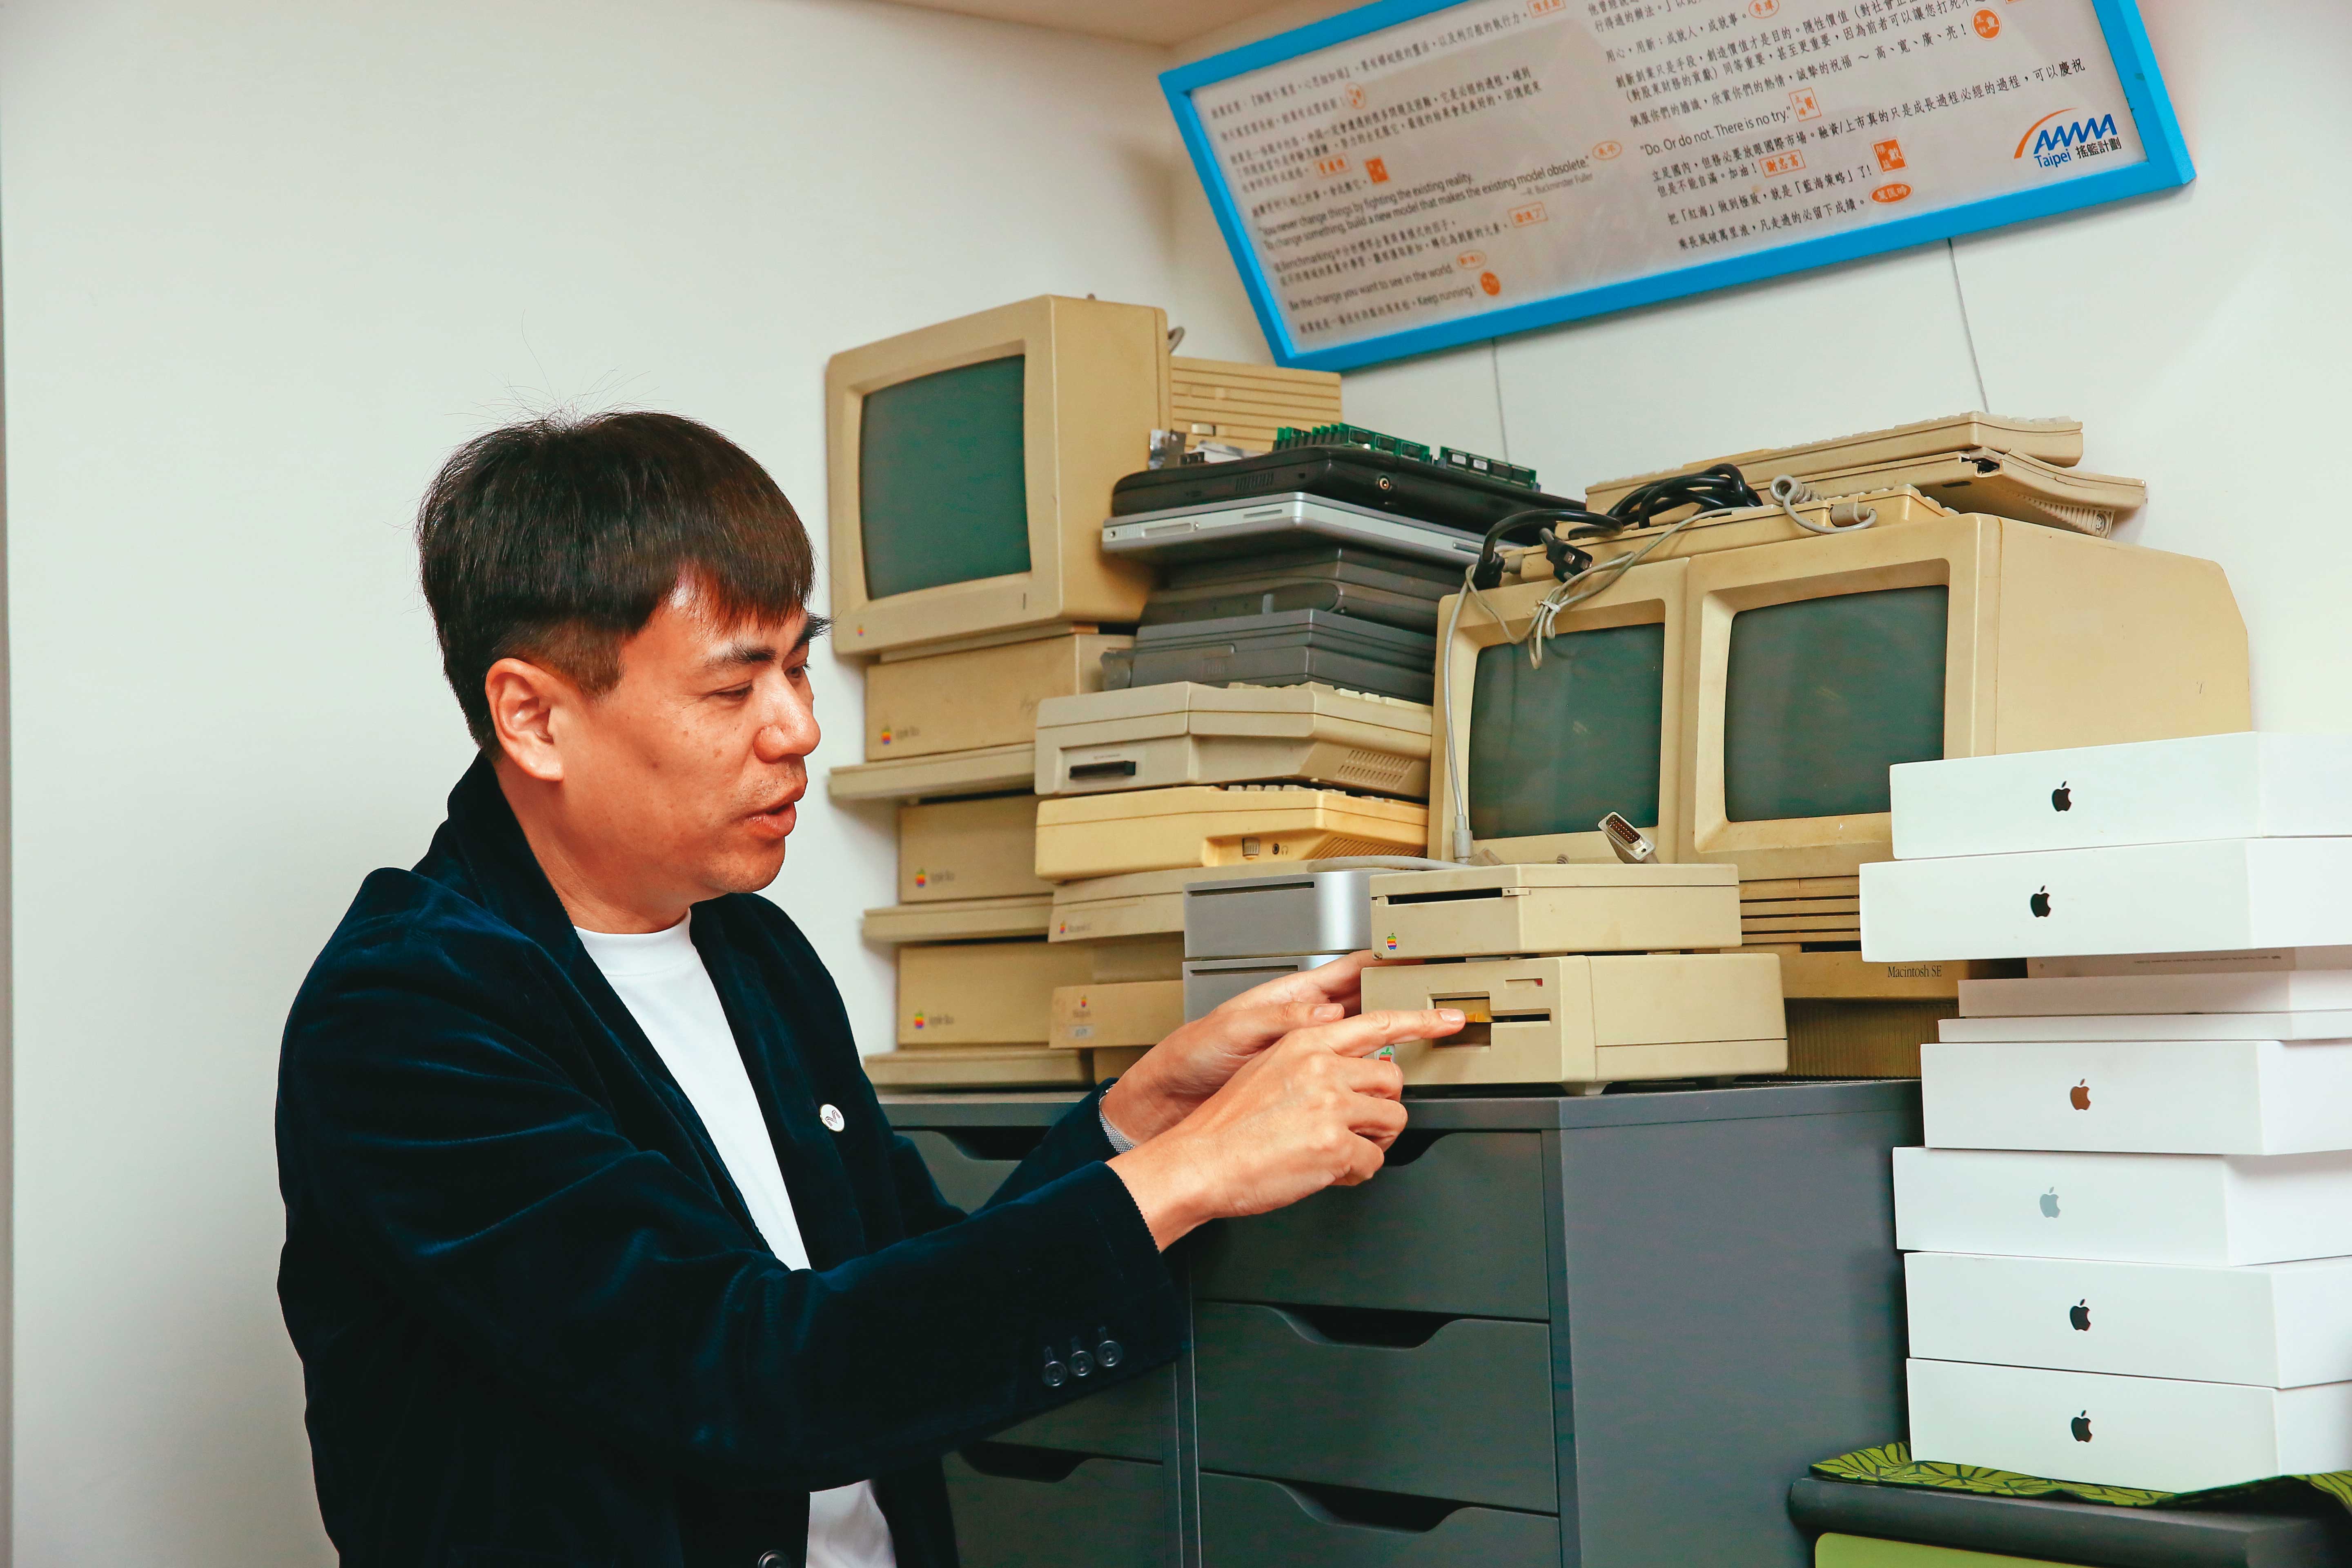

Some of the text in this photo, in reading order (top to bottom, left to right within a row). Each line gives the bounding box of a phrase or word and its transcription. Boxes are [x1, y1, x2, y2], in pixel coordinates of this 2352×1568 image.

[1662, 136, 1679, 151] Or
[1676, 131, 1693, 147] do
[1691, 127, 1715, 143] not.
[1713, 118, 1745, 137] There
[1743, 116, 1755, 129] is
[1754, 113, 1771, 126] no
[2034, 136, 2122, 168] Taipei 搖籃計劃
[1418, 197, 1439, 211] that
[1436, 189, 1466, 205] makes
[1464, 185, 1482, 199] the
[1479, 176, 1518, 197] existing
[1514, 167, 1547, 185] model
[1888, 964, 1942, 978] Macintosh SE
